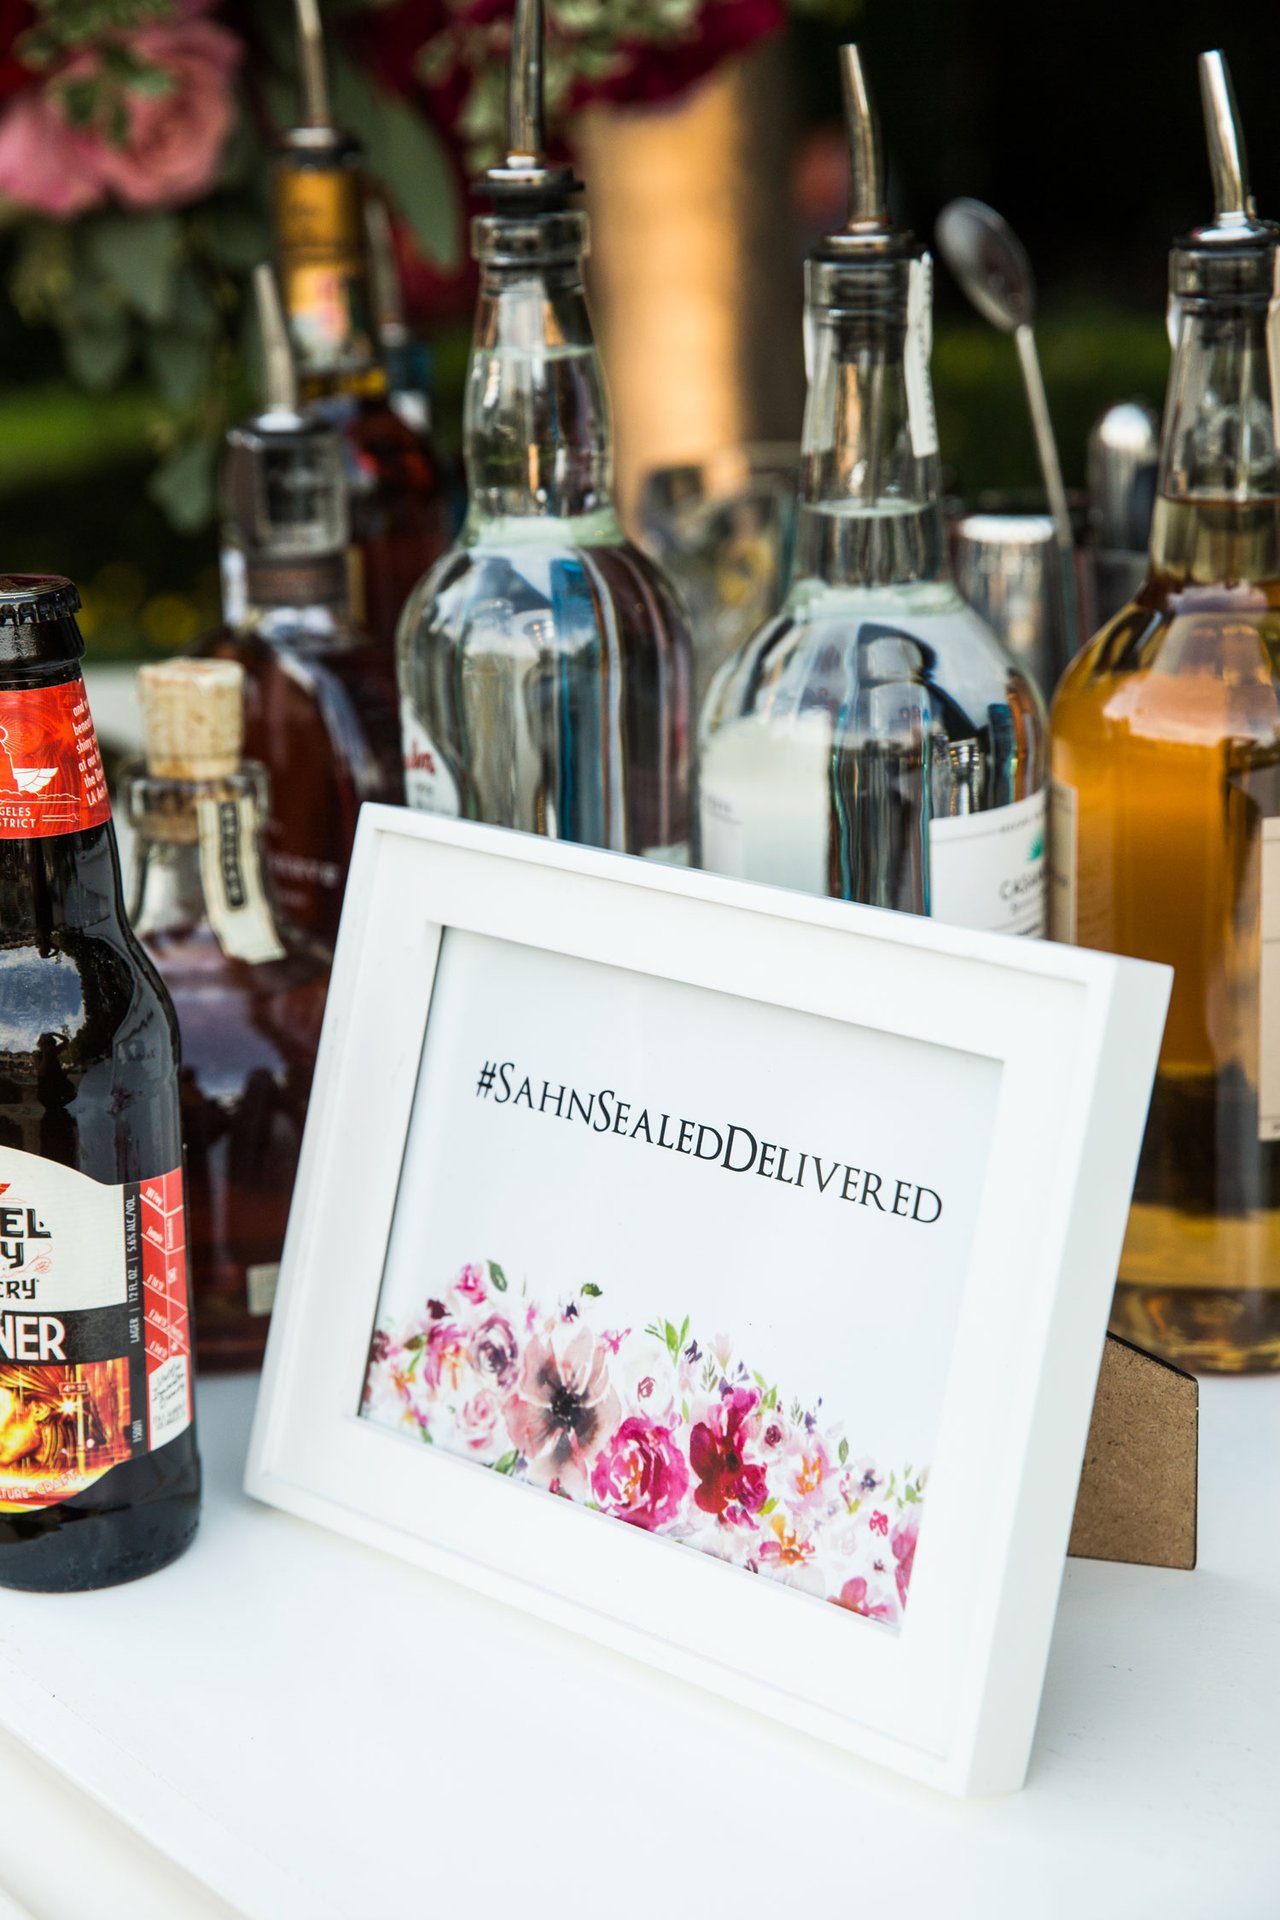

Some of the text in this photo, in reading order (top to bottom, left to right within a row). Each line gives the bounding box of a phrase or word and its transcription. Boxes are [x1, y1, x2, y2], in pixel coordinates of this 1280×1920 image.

[86, 790, 98, 807] LA
[0, 817, 37, 829] TRICT
[129, 1292, 139, 1303] 12
[129, 1317, 140, 1344] LAGER
